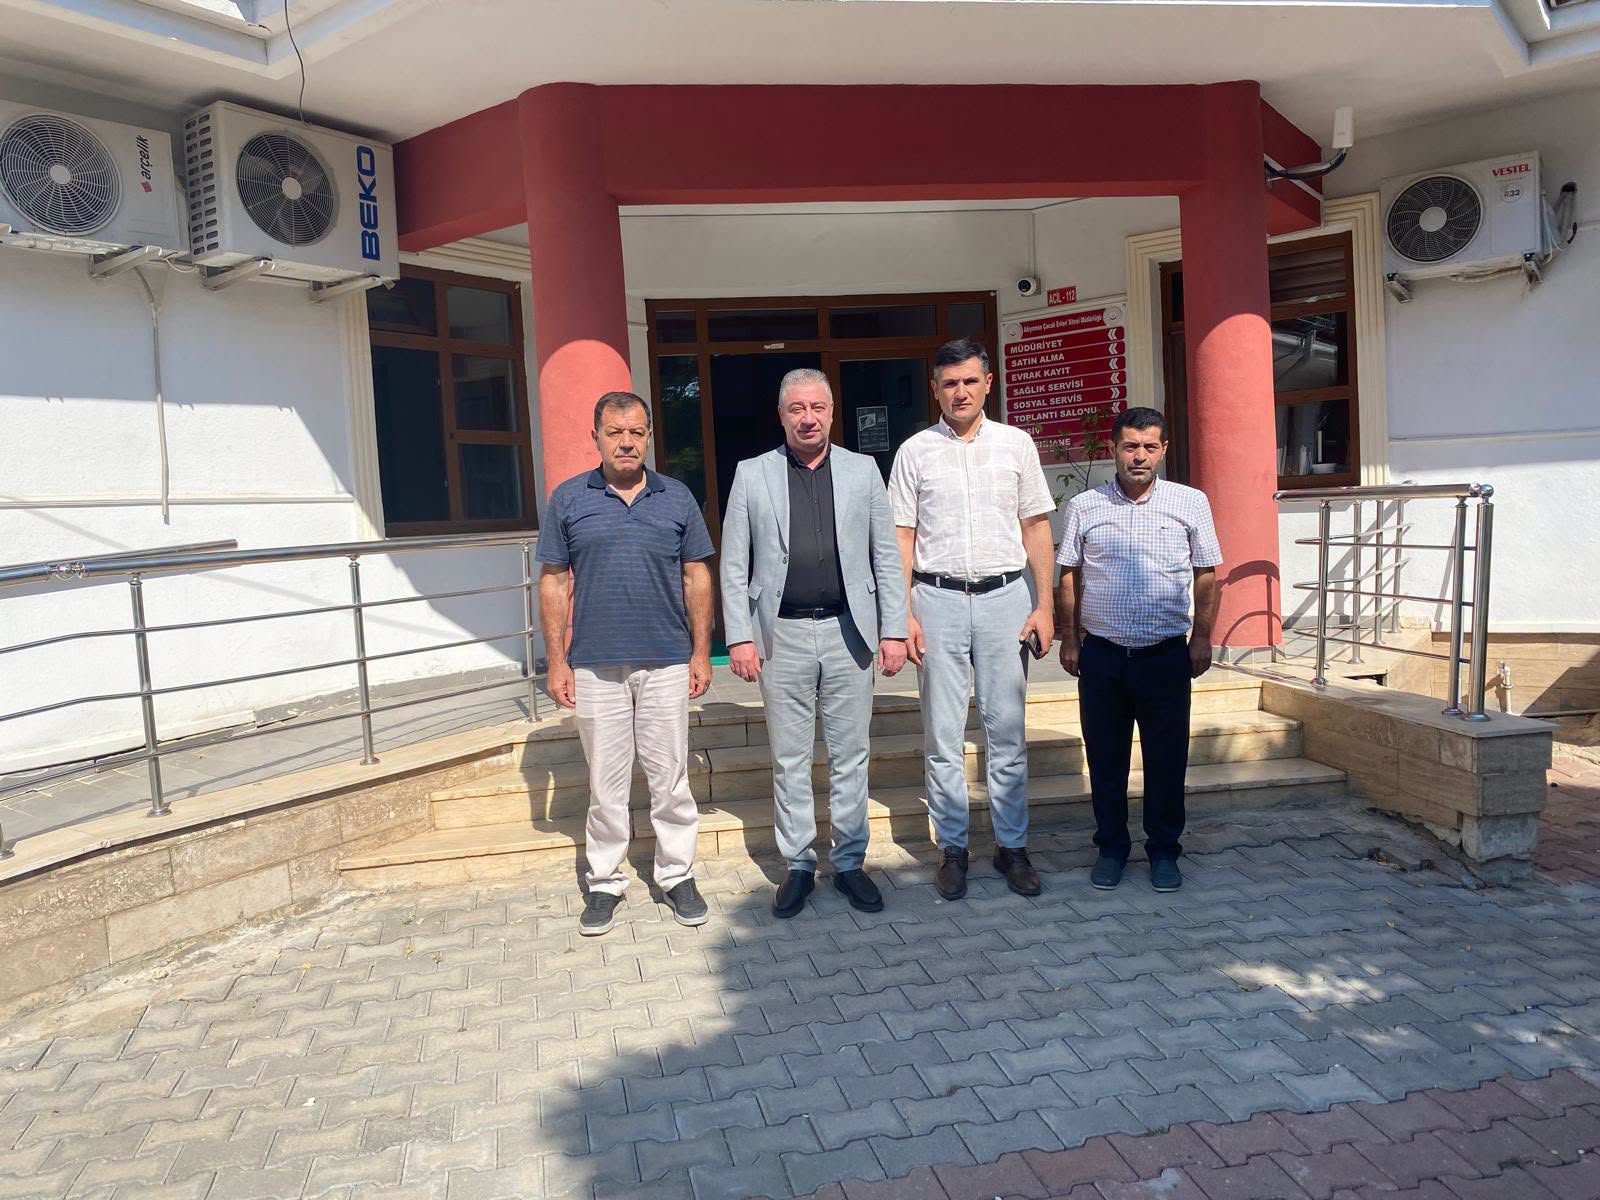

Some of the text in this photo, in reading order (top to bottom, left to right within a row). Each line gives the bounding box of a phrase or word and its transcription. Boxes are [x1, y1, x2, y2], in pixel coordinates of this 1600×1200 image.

[136, 134, 152, 180] arçelik
[1492, 163, 1531, 177] VESTEL
[356, 145, 381, 261] BEKO
[1065, 290, 1075, 302] 112
[1010, 339, 1063, 354] MÜDÜRİYET
[1011, 353, 1065, 368] SATIN ALMA
[1011, 367, 1071, 381] EVRAK KAYIT
[1013, 379, 1084, 396] SAĞLIK SERVİSİ
[1013, 393, 1083, 410] SOSYAL SERVİS
[1014, 407, 1097, 423] TOPLANTI SALONU
